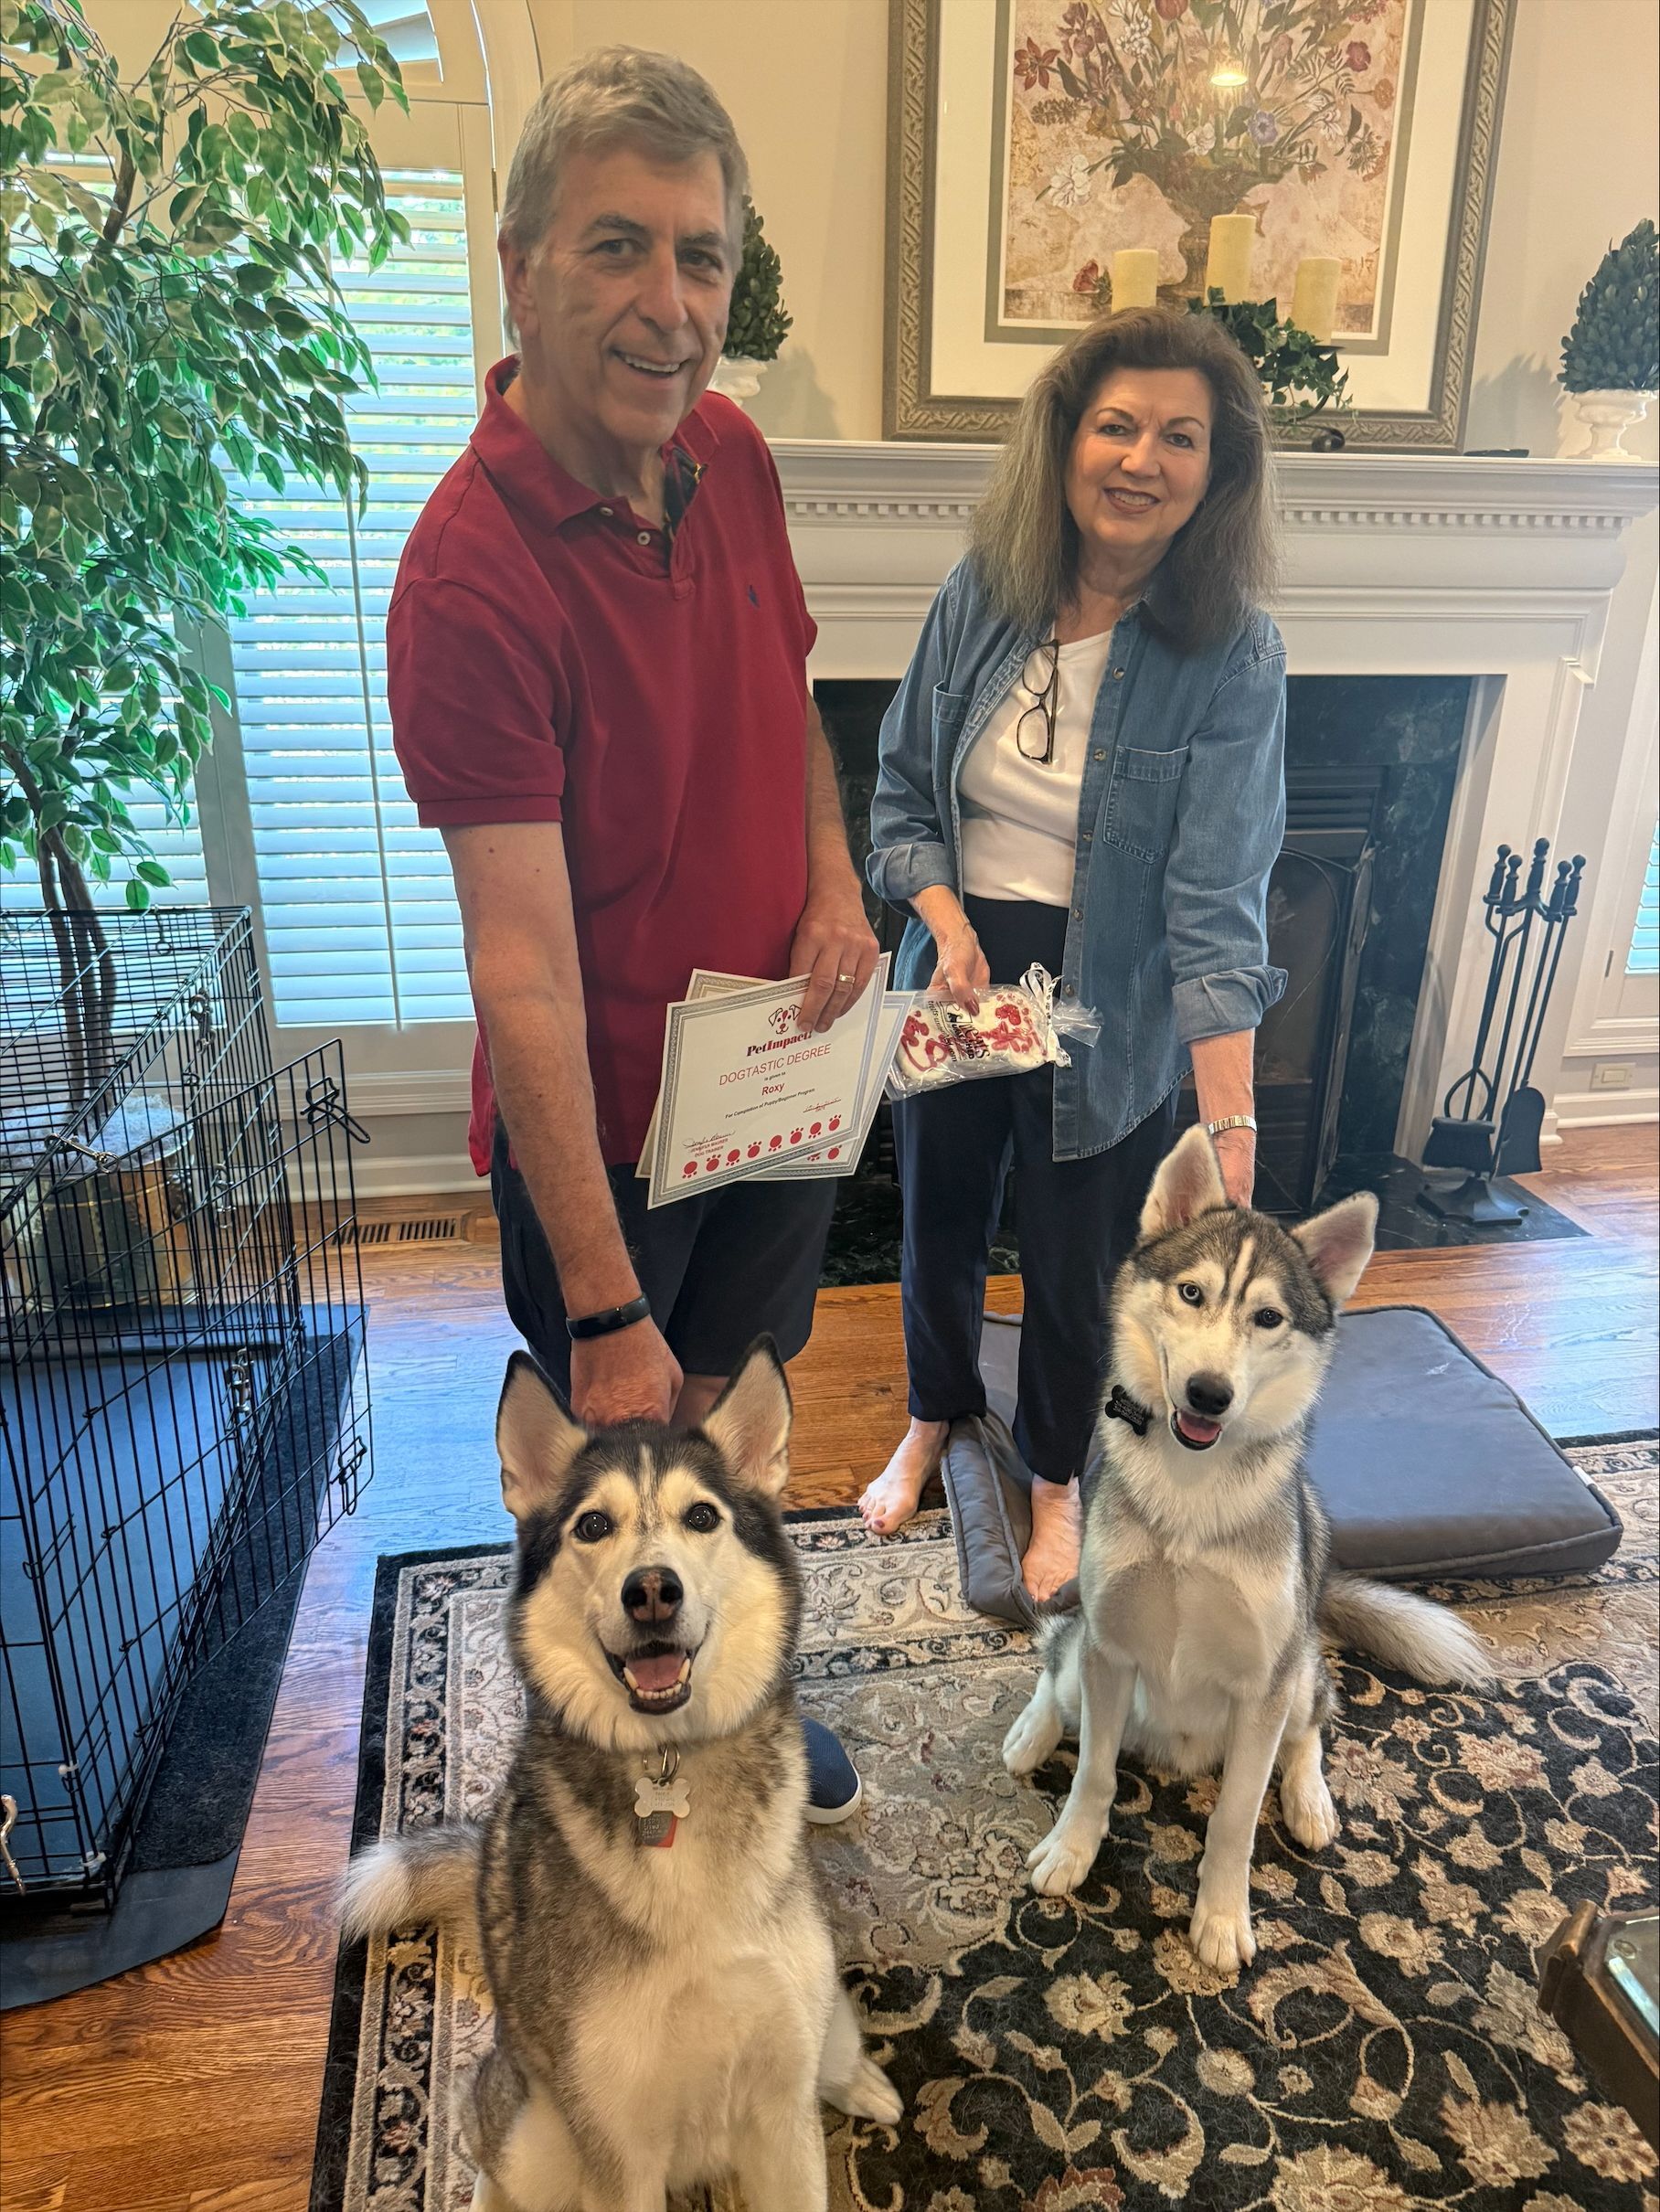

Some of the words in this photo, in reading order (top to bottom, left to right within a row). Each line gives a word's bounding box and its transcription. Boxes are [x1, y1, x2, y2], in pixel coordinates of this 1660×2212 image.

[719, 1058, 784, 1086] DOGTASTIC
[787, 1044, 832, 1066] DEGREE
[733, 1106, 759, 1117] Completion
[797, 1088, 815, 1097] Program
[761, 1083, 785, 1096] Roxy
